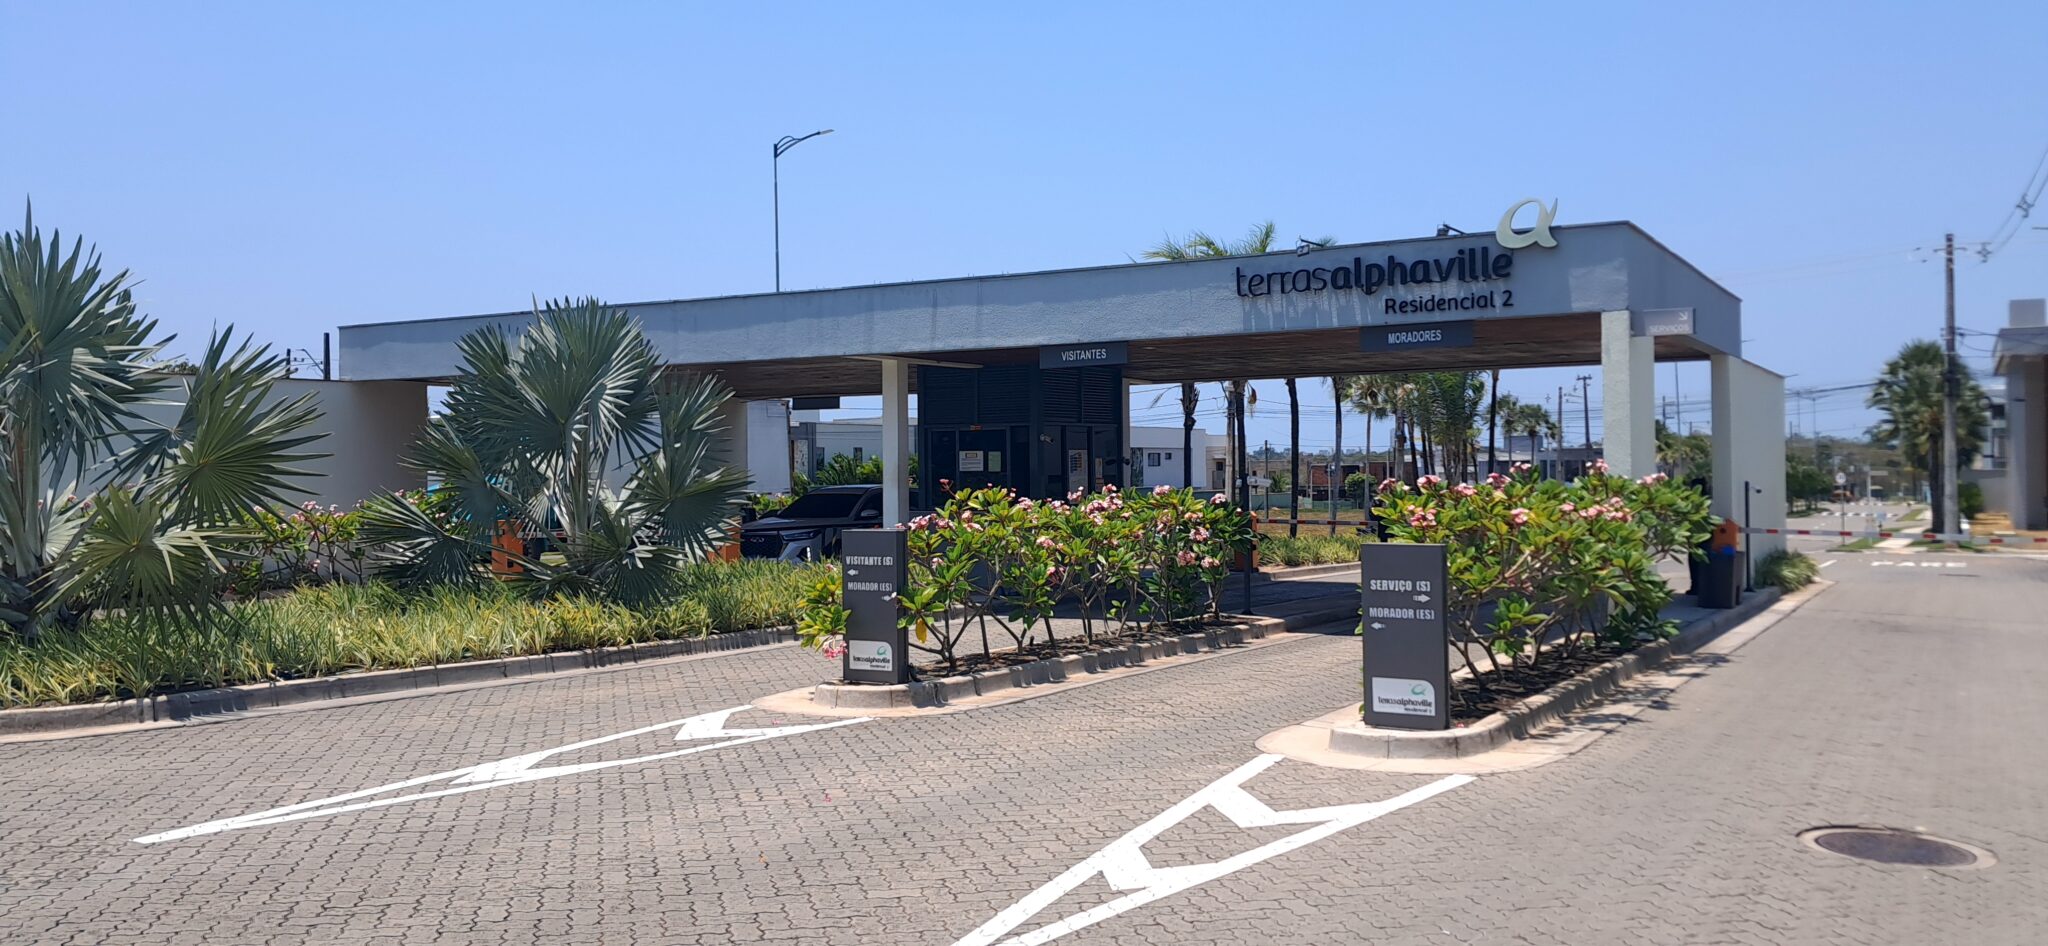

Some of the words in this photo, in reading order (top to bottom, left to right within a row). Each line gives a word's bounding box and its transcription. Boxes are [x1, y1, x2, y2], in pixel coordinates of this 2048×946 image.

[1385, 291, 1496, 314] Residencial
[1502, 289, 1514, 306] 2
[1388, 329, 1442, 344] MORADORES
[1061, 348, 1107, 361] VISITANTES
[845, 555, 882, 566] VISITANTE
[847, 581, 879, 591] MORADOR
[1370, 579, 1412, 593] SERVIÇO
[1369, 607, 1415, 619] MORADOR
